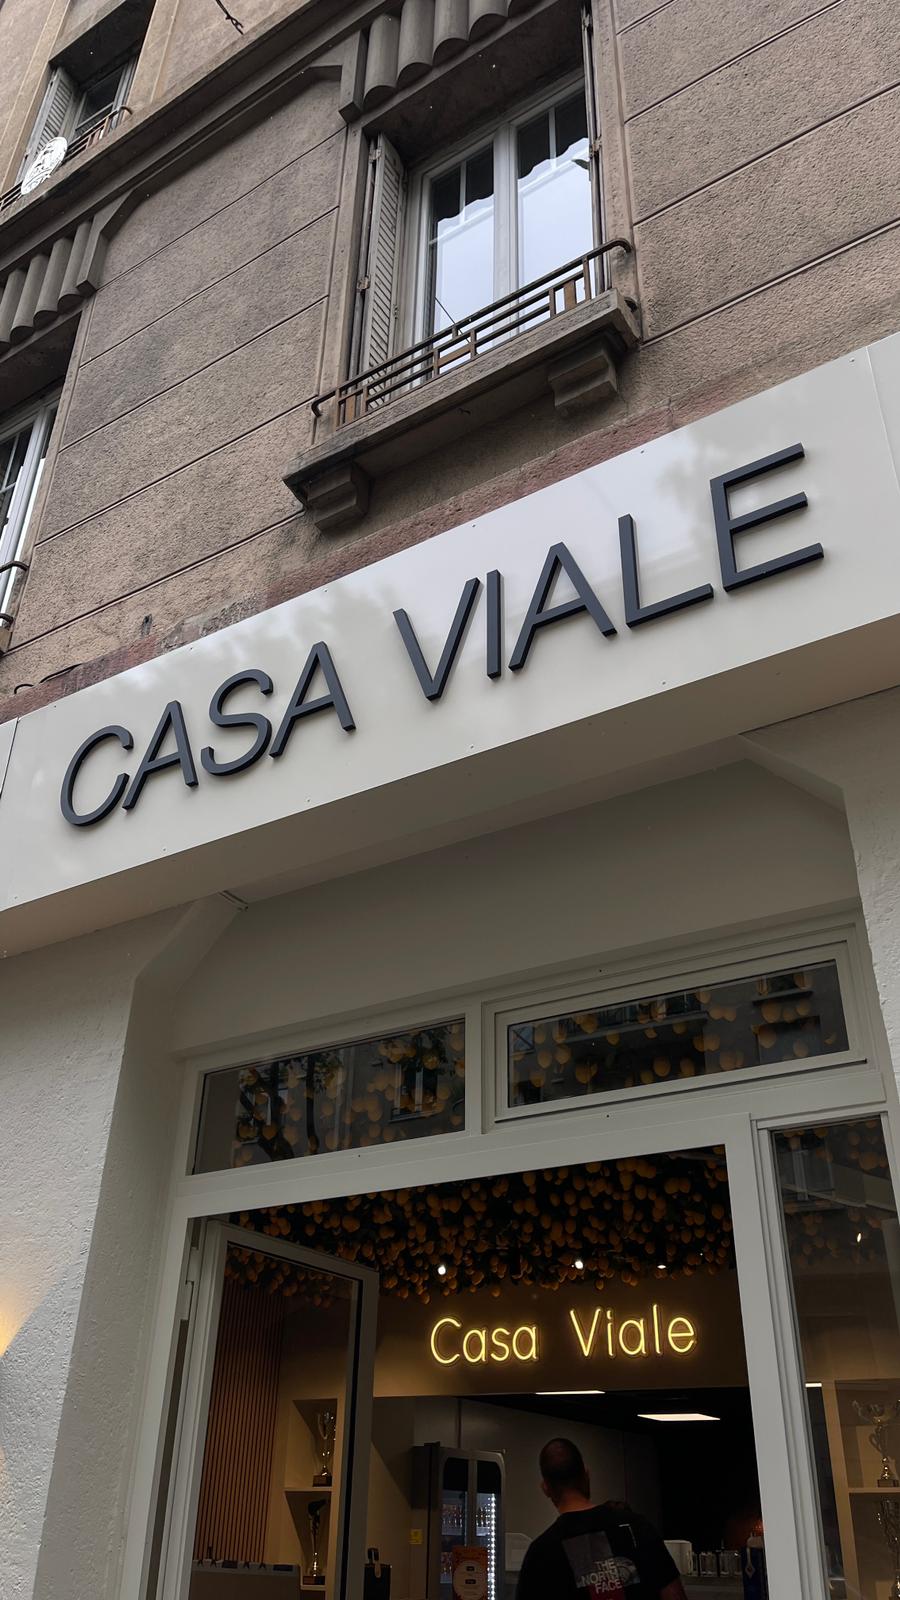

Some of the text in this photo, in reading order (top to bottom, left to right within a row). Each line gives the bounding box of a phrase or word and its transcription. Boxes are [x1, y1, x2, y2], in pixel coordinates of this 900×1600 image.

[60, 442, 824, 827] CASA VIALE
[430, 1304, 696, 1364] Casa Viale
[595, 1557, 616, 1570] THE
[581, 1568, 619, 1585] NORTH
[595, 1578, 623, 1595] FACE
